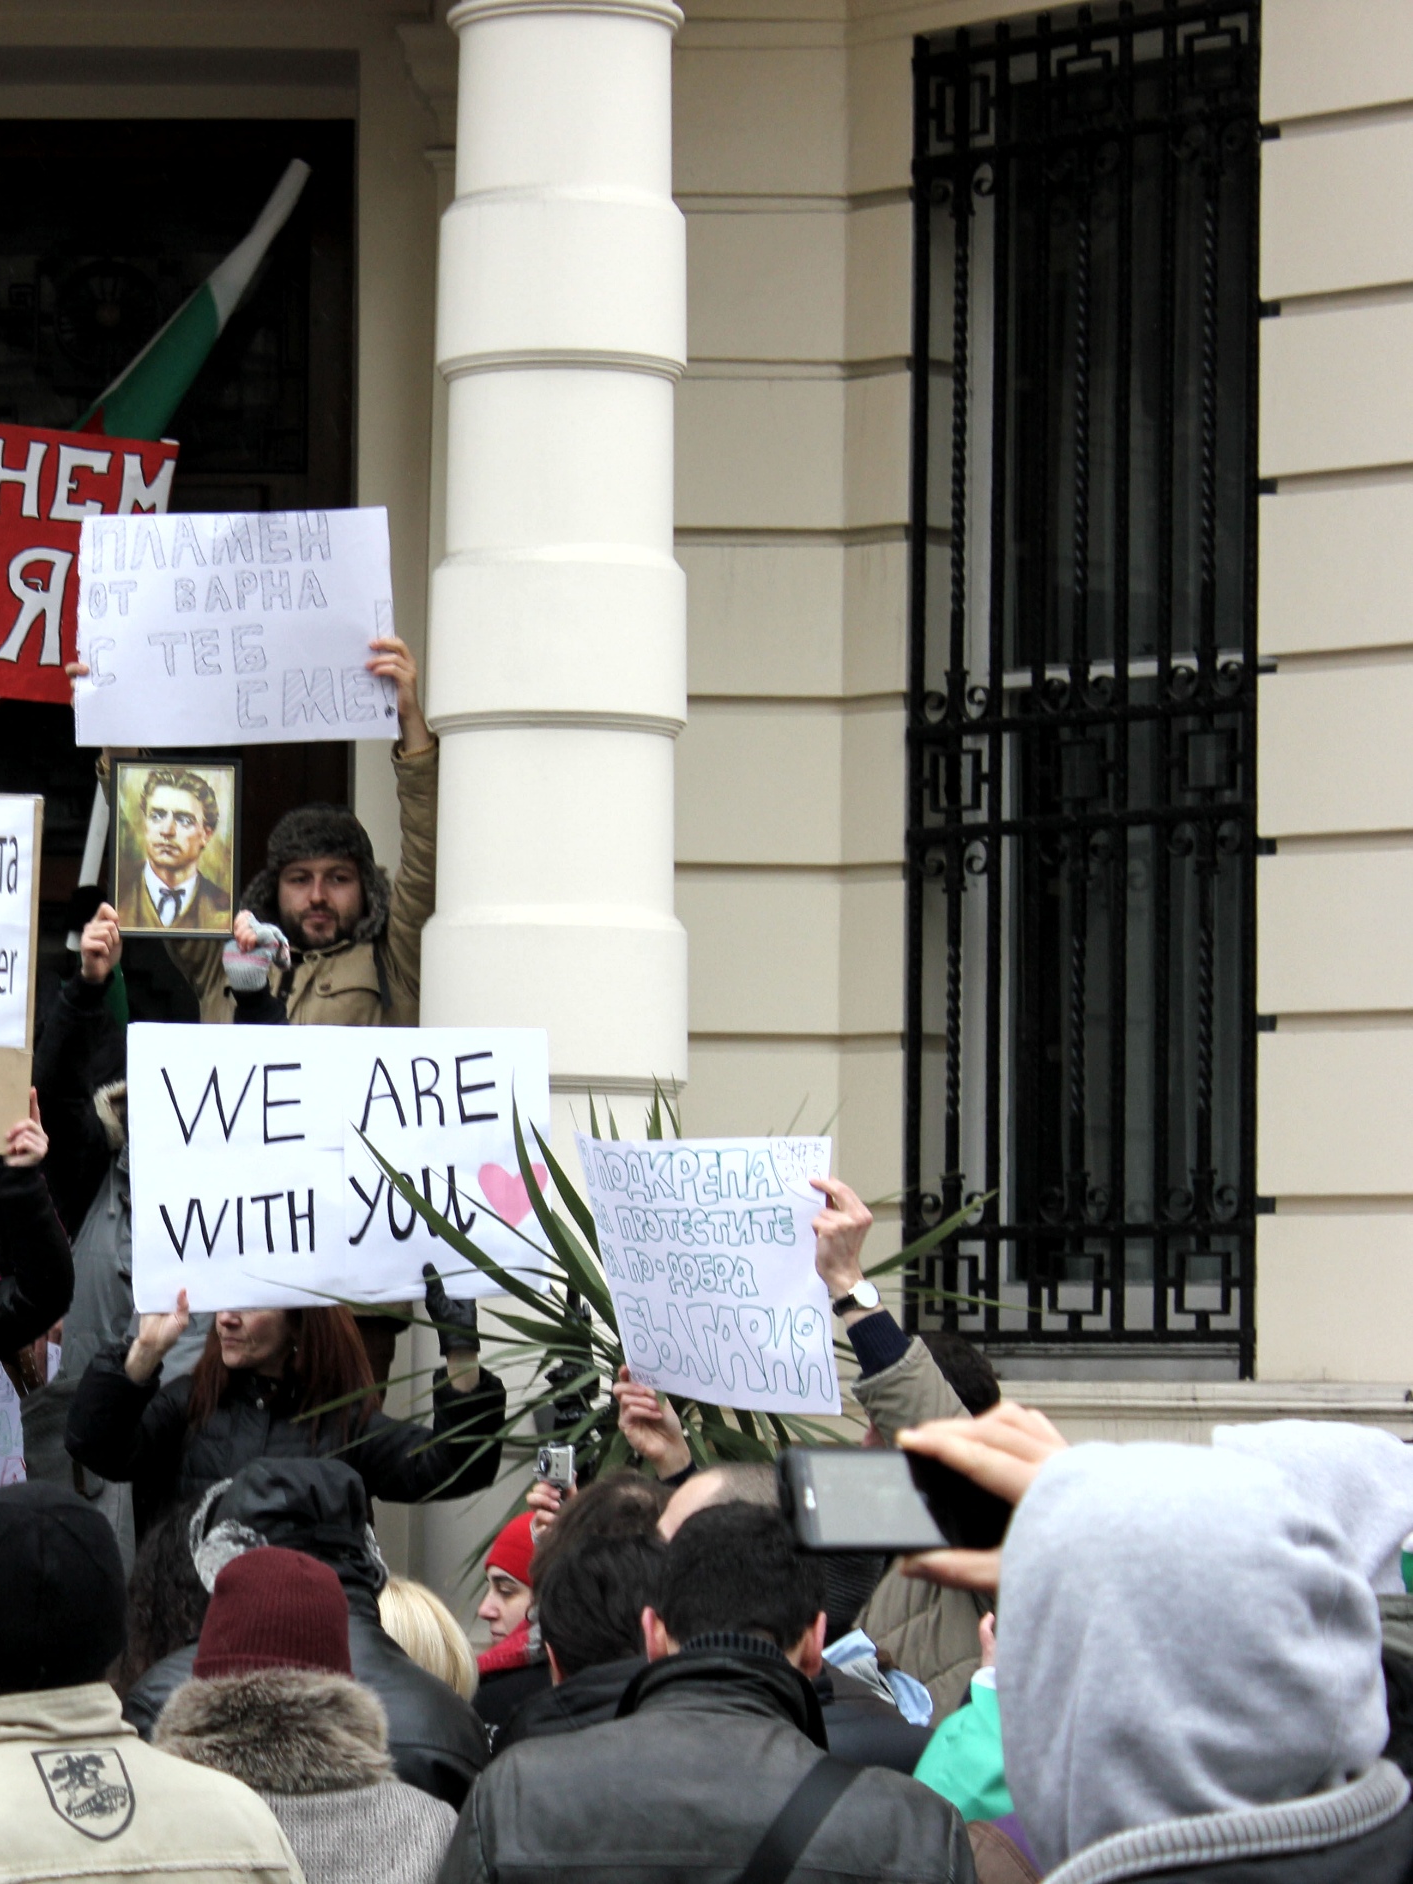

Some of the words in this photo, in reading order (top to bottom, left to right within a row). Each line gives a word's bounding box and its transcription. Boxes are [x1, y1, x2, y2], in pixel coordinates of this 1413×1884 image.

[91, 510, 332, 574] ПЛАМЕН
[88, 579, 138, 620] ОТ
[175, 568, 329, 613] ВАРНА
[88, 637, 116, 688] С
[147, 623, 267, 678] ТЕБ
[160, 1062, 306, 1146] WE
[360, 1051, 499, 1133] ARE
[593, 1147, 785, 1207] ПОДКРЕПА
[158, 1188, 315, 1262] WITH
